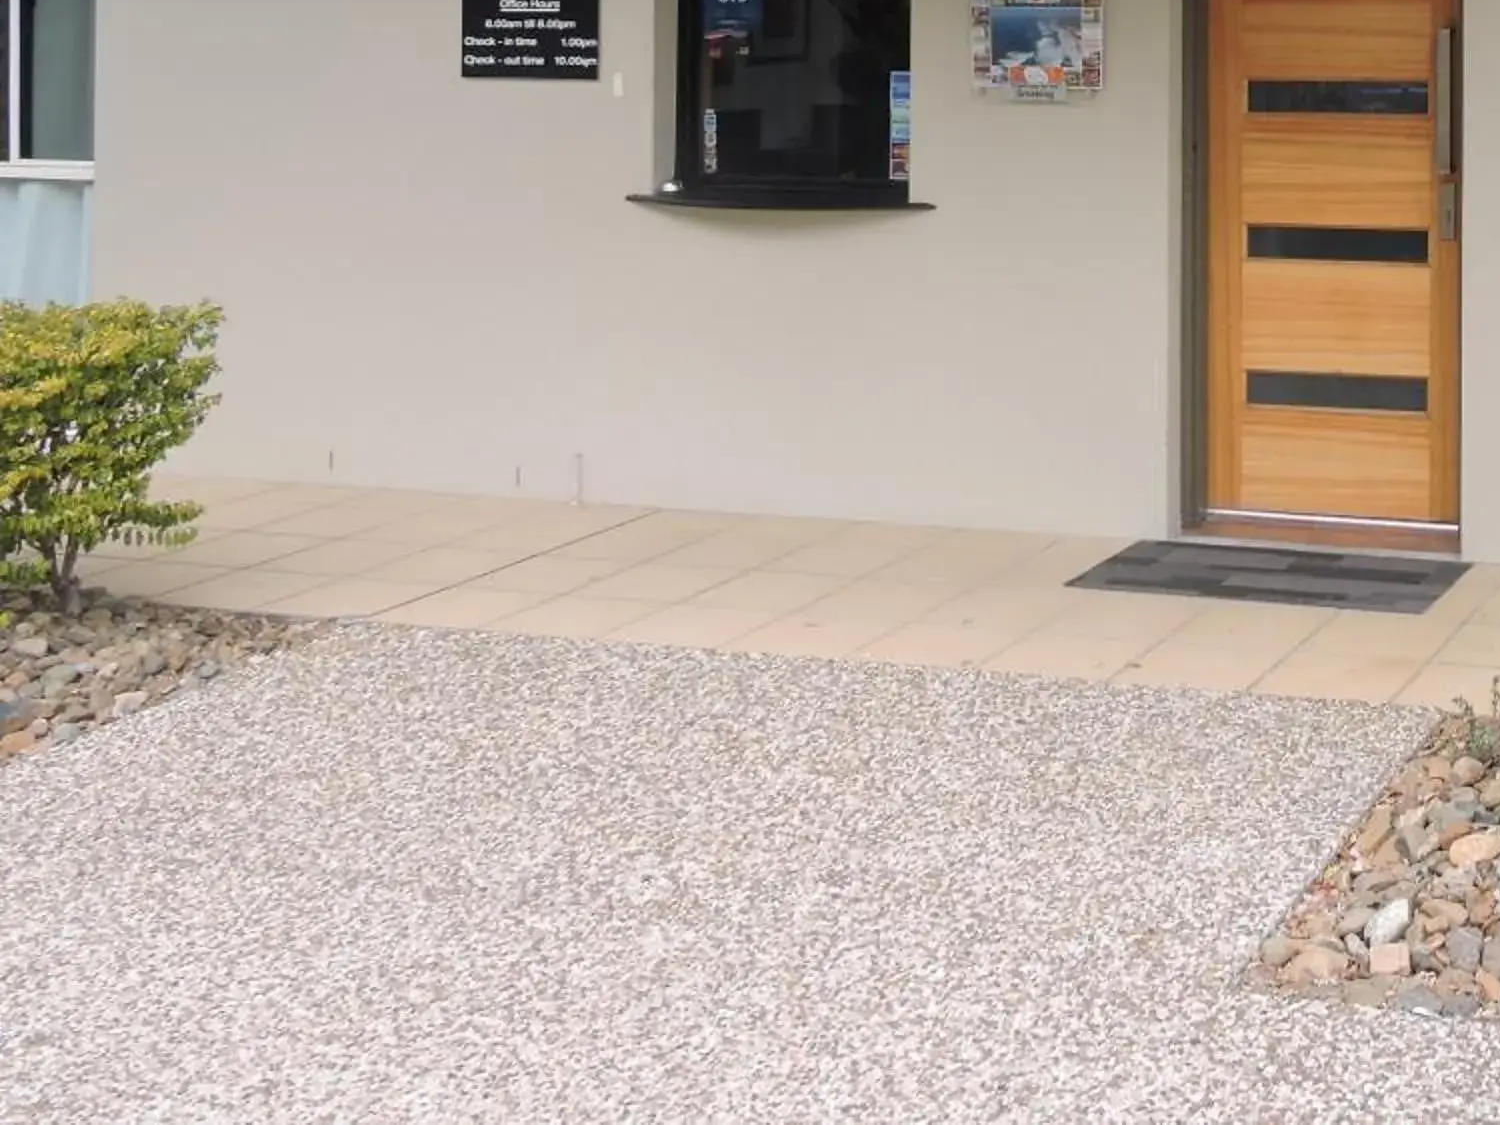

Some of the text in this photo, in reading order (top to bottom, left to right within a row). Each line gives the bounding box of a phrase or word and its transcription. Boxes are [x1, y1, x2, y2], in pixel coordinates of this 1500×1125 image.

[499, 0, 560, 8] Office Hours
[464, 36, 496, 46] Check
[504, 36, 513, 46] in
[515, 36, 538, 46] time
[464, 54, 496, 65] Check
[504, 56, 521, 65] out
[522, 56, 545, 65] time
